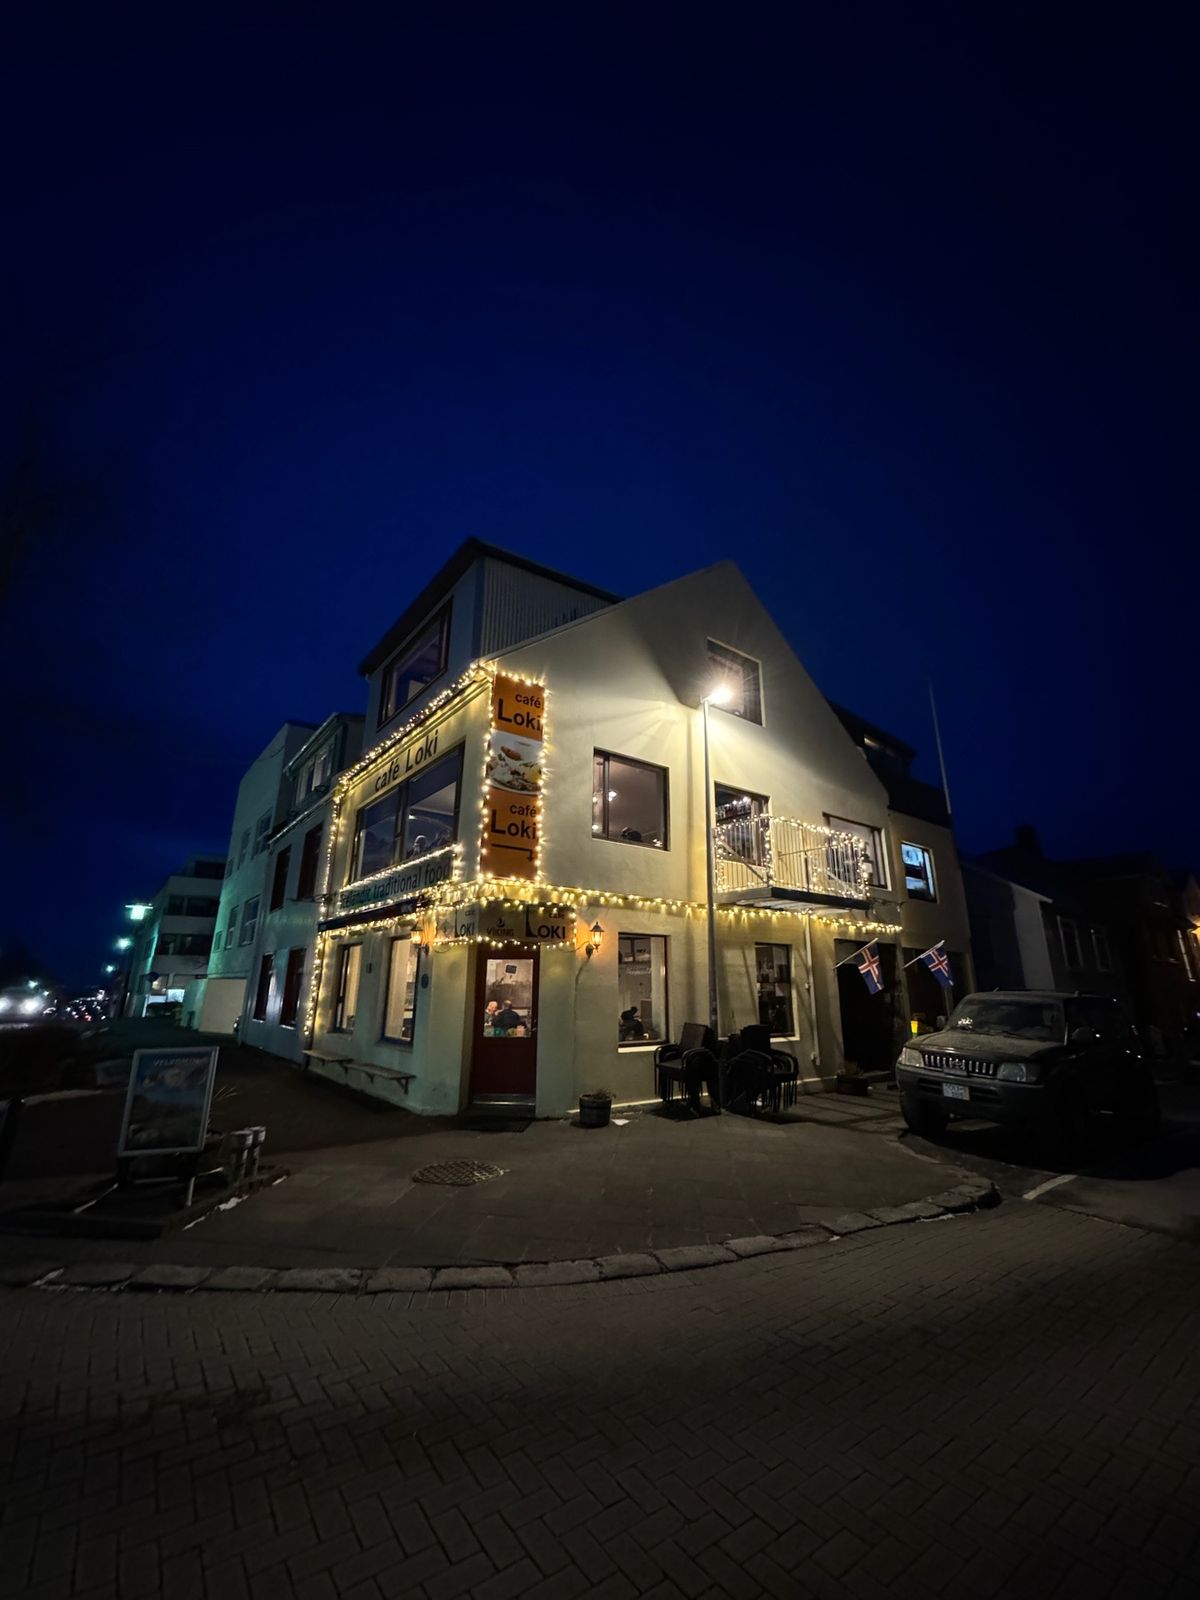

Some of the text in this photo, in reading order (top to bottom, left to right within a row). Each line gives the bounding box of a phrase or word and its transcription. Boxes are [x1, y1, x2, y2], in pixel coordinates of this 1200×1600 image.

[498, 698, 541, 731] Loki
[515, 693, 541, 709] café
[375, 730, 439, 792] café Loki
[491, 809, 536, 839] Loki
[510, 804, 537, 818] café
[373, 866, 421, 900] traditional
